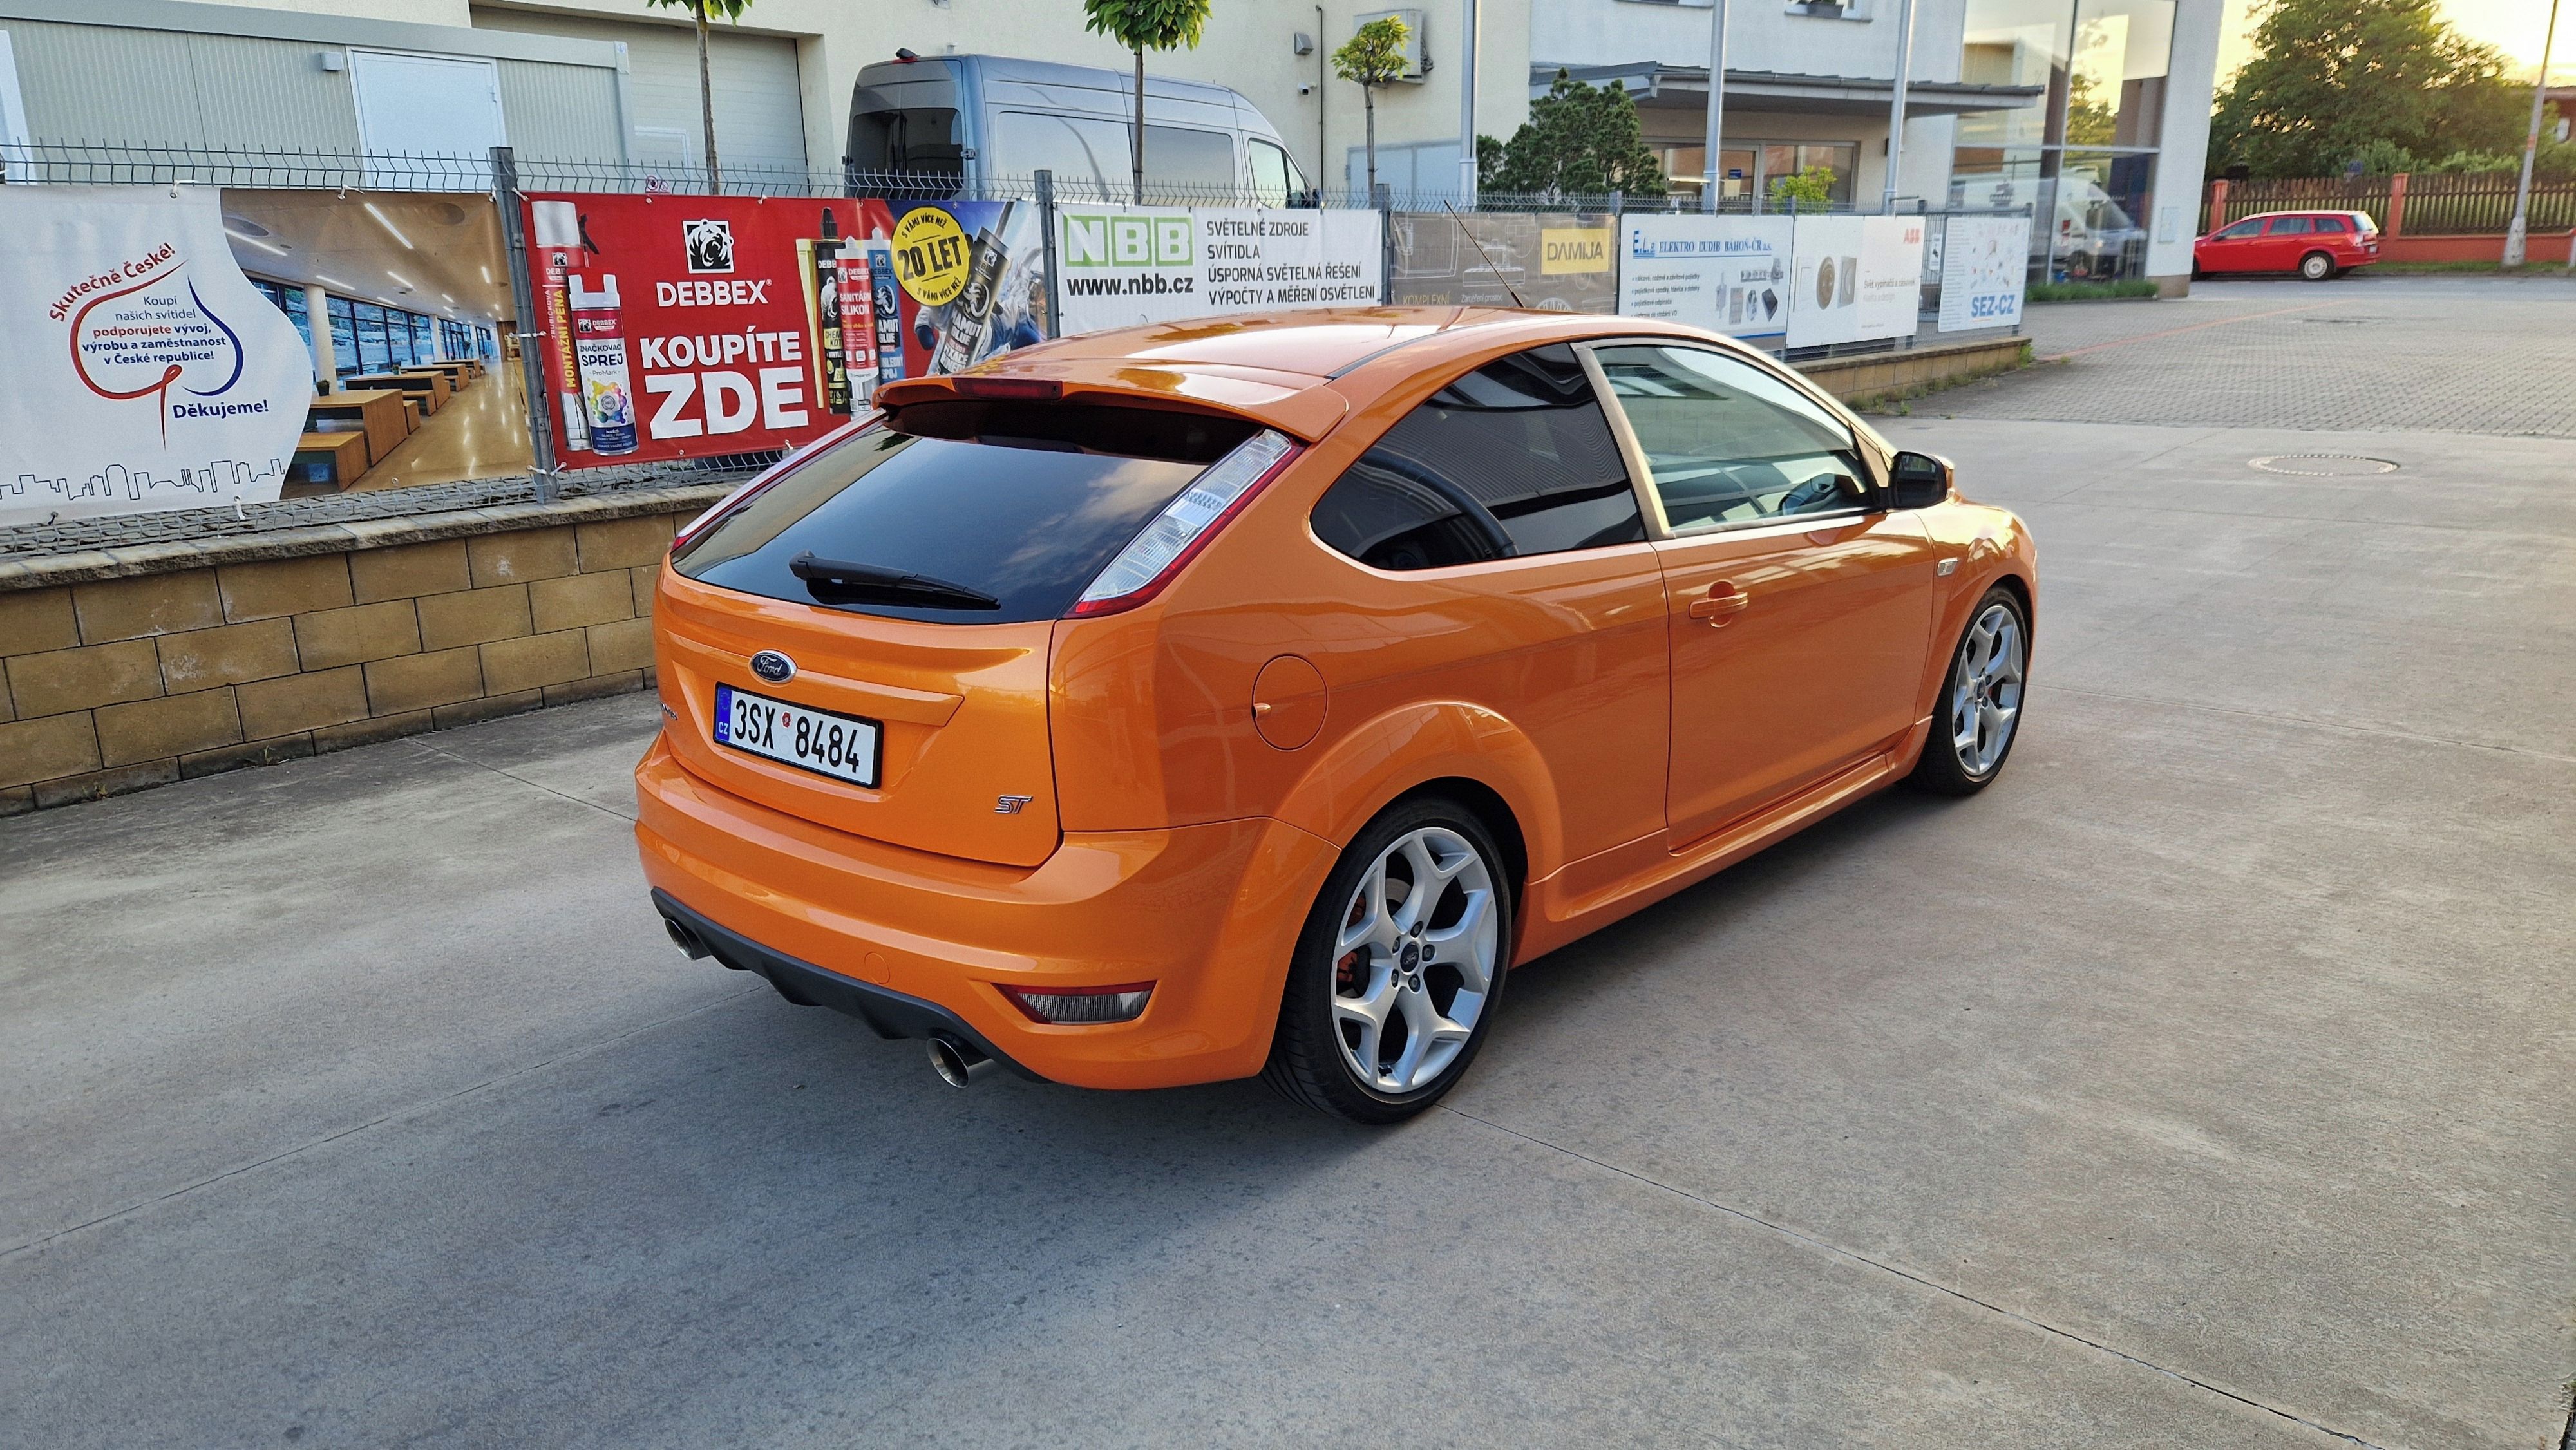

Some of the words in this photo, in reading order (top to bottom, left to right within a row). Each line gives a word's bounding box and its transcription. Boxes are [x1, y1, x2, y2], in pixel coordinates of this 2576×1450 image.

[904, 216, 920, 233] VÁMI
[921, 212, 934, 224] VÍCE
[935, 216, 949, 229] NEŽ
[1207, 218, 1265, 236] SVĚTELNÉ
[1269, 222, 1309, 236] ZDROJE
[1066, 219, 1191, 263] NBB
[1904, 228, 1920, 244] ABB
[1208, 241, 1260, 259] SVÍTIDLA
[1547, 241, 1604, 262] DAMIJA
[1659, 241, 1694, 253] ELEKTRO
[898, 246, 926, 281] 20
[927, 235, 962, 272] LET
[48, 268, 122, 322] Skutečně
[122, 242, 176, 278] České!
[1208, 263, 1264, 283] ÚSPORNÁ
[1267, 262, 1322, 281] SVĚTELNÁ
[1325, 261, 1361, 279] ŘEŠENÍ
[923, 288, 938, 301] VÁMI
[938, 287, 953, 300] VÍCE
[952, 276, 961, 291] NEŽ
[1067, 273, 1193, 296] www.nbb.cz
[1209, 286, 1263, 306] VÝPOČTY
[1267, 289, 1274, 303] A
[1278, 284, 1318, 303] MĚŘENÍ
[1320, 282, 1376, 302] OSVĚTLENÍ
[144, 296, 178, 308] Koupí
[553, 289, 567, 323] PĚNA
[840, 305, 871, 315] SILIKON
[1971, 295, 2016, 317] SEZ-CZ
[115, 310, 153, 321] našich
[155, 309, 196, 321] svítidel
[93, 325, 172, 339] podporujete
[174, 323, 211, 335] vývoj,
[878, 319, 899, 333] AMUT
[82, 341, 128, 353] výrobu
[140, 337, 227, 350] zaměstnanost
[640, 325, 802, 368] KOUPÍTE
[114, 353, 151, 364] České
[153, 350, 214, 364] republice!
[556, 325, 576, 388] MONTÁŽNÍ
[582, 353, 623, 366] SPREJ
[173, 399, 269, 419] Děkujeme!
[645, 366, 809, 440] ZDE
[757, 655, 783, 676] Ford
[718, 721, 729, 735] CZ
[734, 699, 775, 749] 3SX
[795, 715, 860, 773] 8484
[994, 795, 1034, 814] ST
